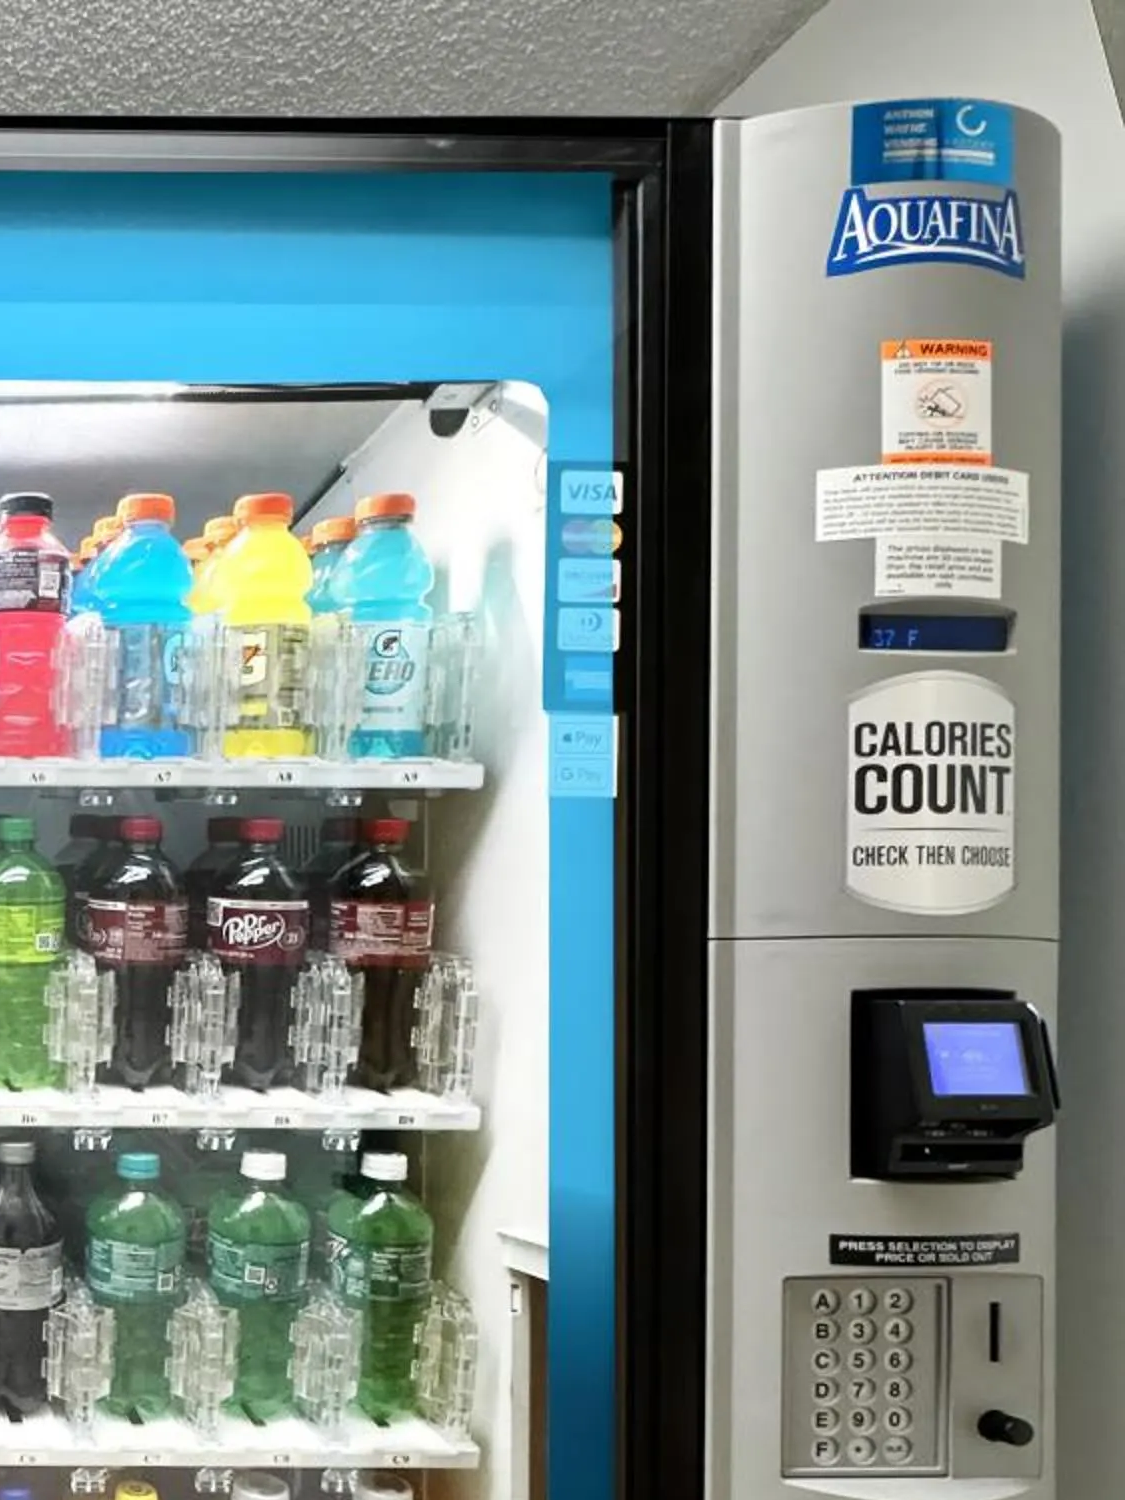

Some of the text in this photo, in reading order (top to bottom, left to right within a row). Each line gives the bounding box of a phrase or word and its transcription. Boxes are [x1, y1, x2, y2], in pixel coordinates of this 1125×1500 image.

[834, 193, 1023, 264] AQUAFINA
[920, 343, 987, 357] WARNING
[852, 471, 918, 483] ATTENTION
[920, 471, 950, 480] DEBIT
[567, 483, 618, 501] VISA
[908, 629, 920, 648] F
[366, 660, 416, 682] ERO
[854, 720, 1013, 759] CALORIES
[155, 772, 172, 783] A7
[854, 763, 1012, 815] COUNT
[851, 845, 1012, 868] CHECK THEN CHOOSE
[227, 917, 280, 946] Pepper
[838, 1239, 884, 1252] PRESS
[888, 1240, 957, 1252] SELECTION
[960, 1241, 975, 1251] TO
[875, 1251, 995, 1264] PRICE OR SOLD OUT
[815, 1292, 902, 1310] A 1 2
[816, 1323, 900, 1339] B 3 4
[815, 1352, 901, 1369] C 5 6
[815, 1382, 900, 1399] D 7 8
[816, 1411, 900, 1428] E 9 0
[816, 1441, 828, 1457] F
